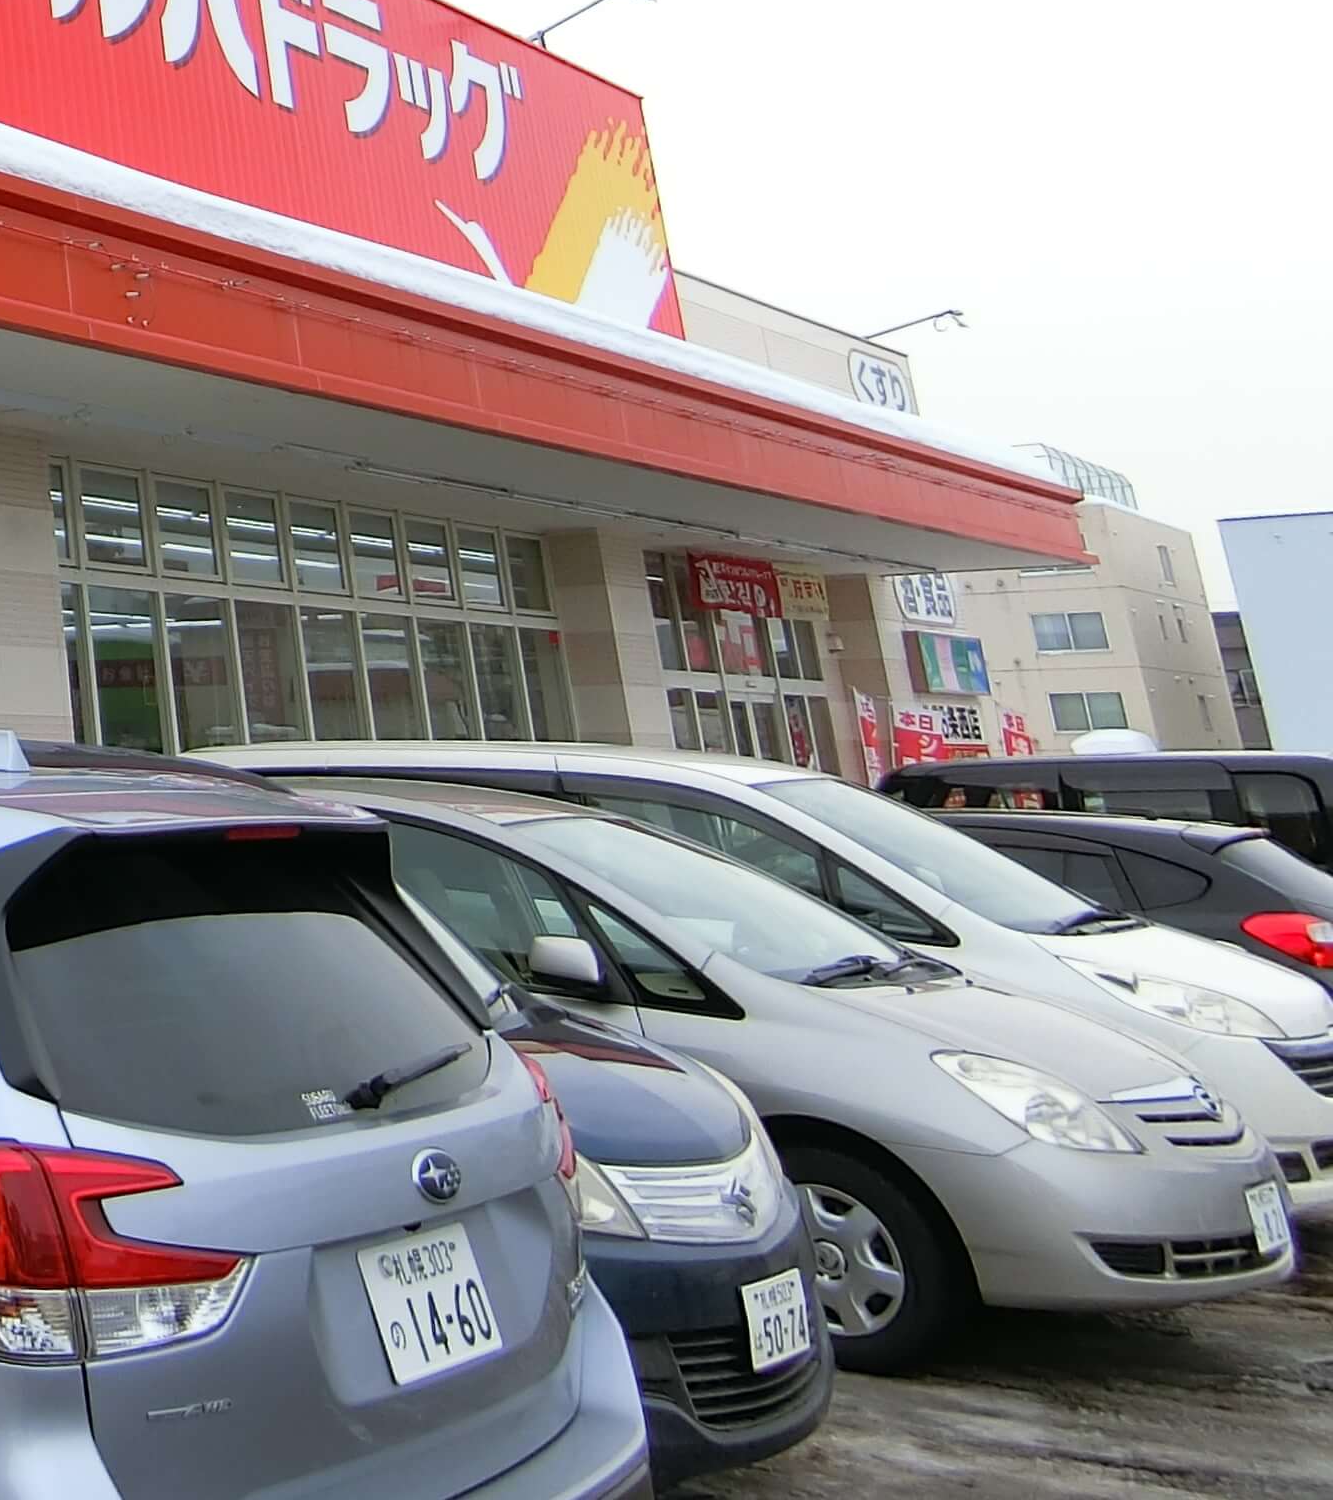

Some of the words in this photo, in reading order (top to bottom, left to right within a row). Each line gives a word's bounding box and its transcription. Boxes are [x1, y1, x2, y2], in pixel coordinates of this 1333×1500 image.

[857, 360, 906, 412] くすり
[898, 709, 934, 732] 本日
[389, 1320, 407, 1350] の
